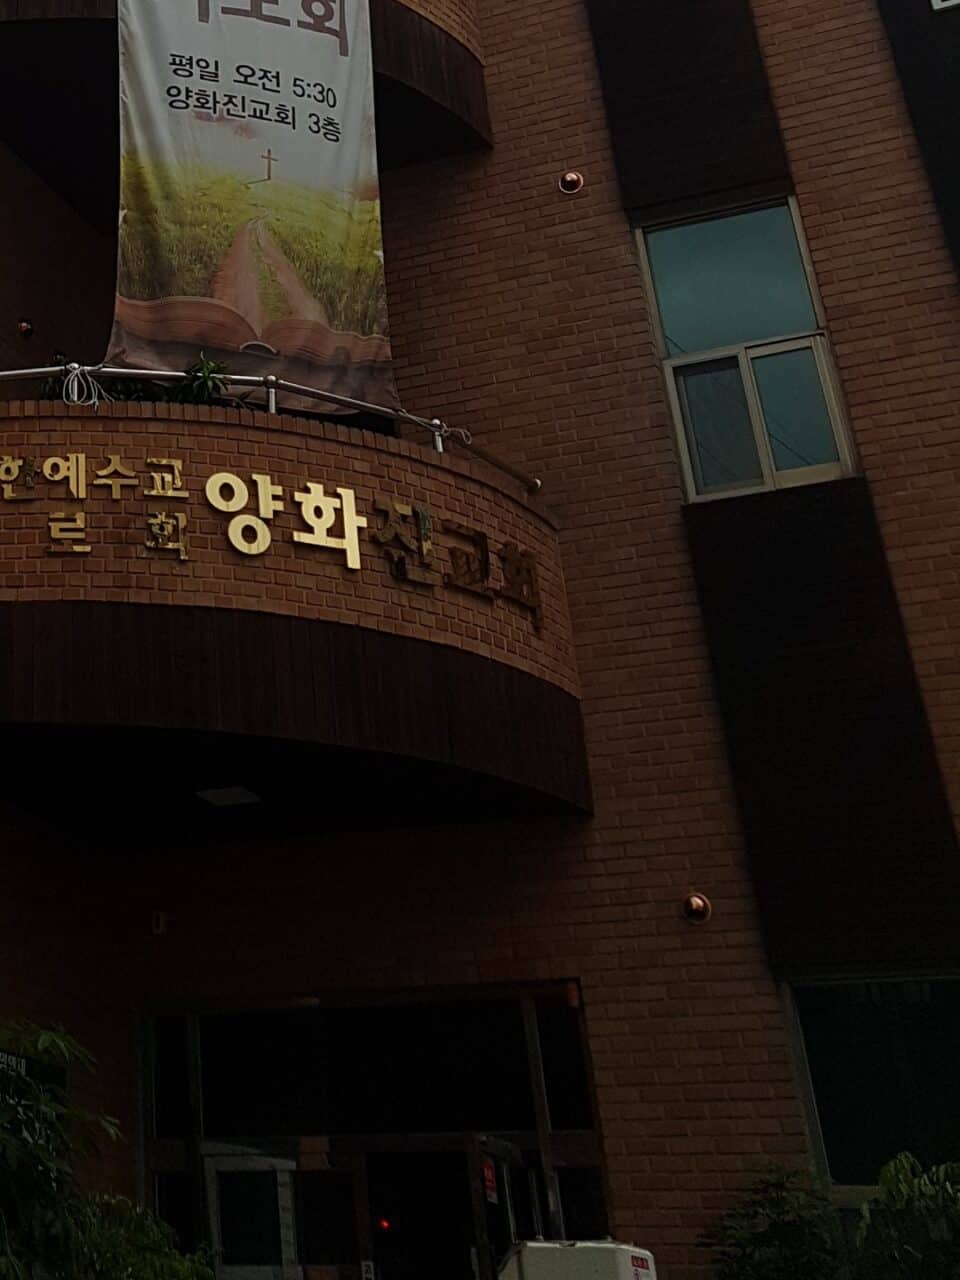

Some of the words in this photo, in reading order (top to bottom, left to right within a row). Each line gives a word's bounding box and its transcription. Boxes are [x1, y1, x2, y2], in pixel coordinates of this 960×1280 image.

[168, 52, 220, 83] 평일
[232, 63, 282, 94] 오전
[292, 76, 338, 109] 5:30
[165, 84, 297, 130] 양화진교회
[307, 112, 342, 144] 3층
